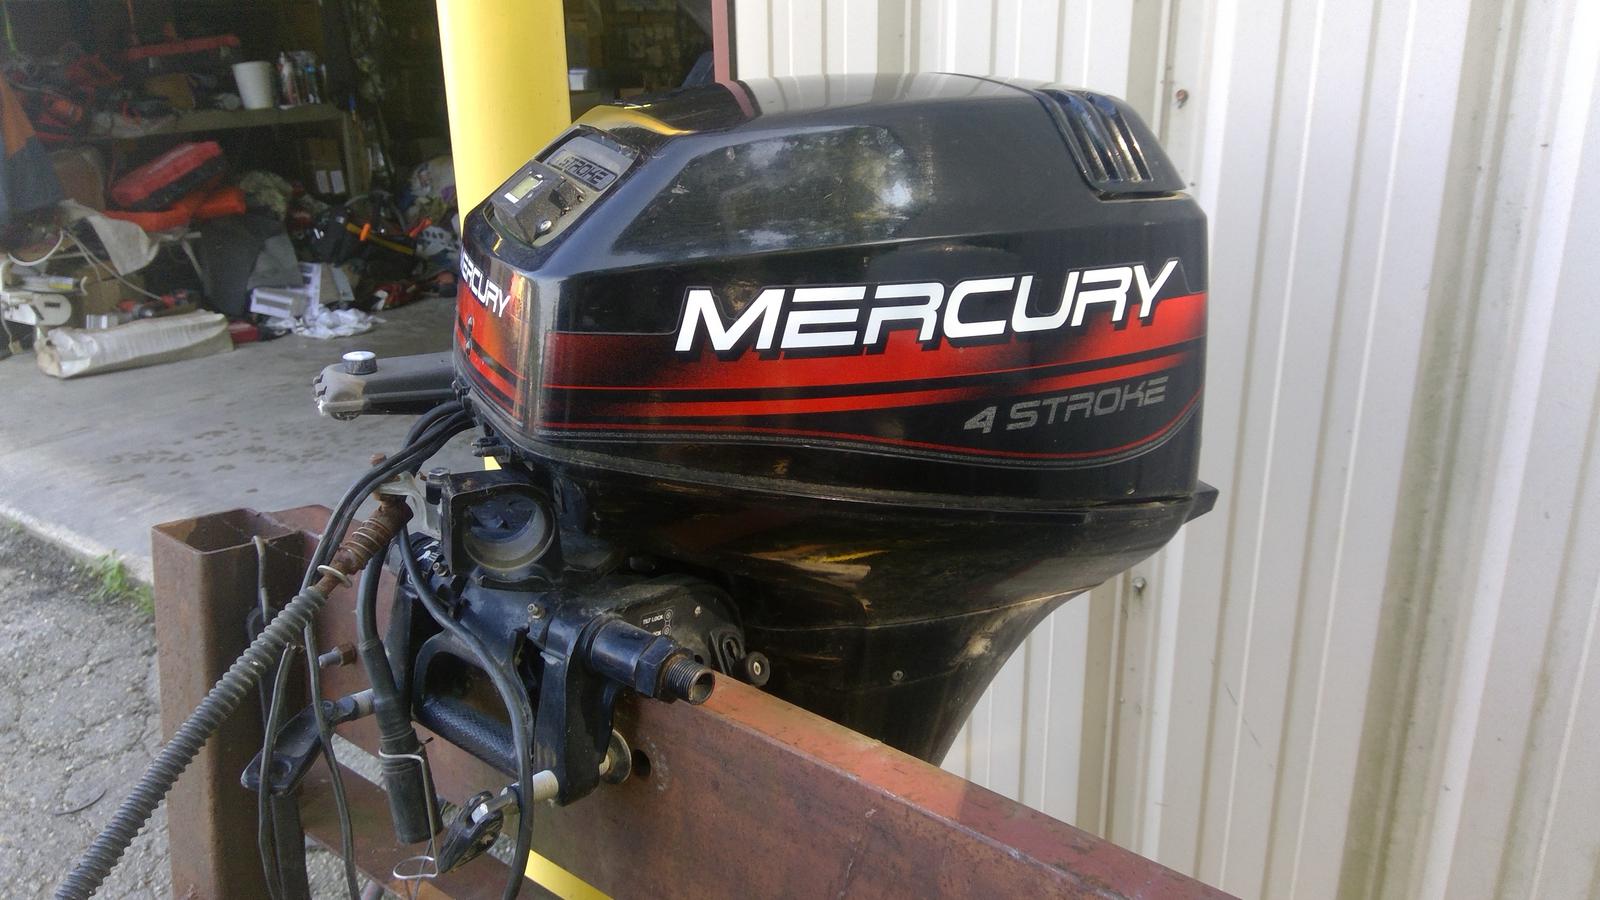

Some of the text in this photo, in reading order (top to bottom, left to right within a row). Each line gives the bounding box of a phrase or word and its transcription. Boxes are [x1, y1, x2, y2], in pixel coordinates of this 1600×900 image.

[460, 245, 511, 317] ERCURY
[675, 260, 1178, 353] MERCURY
[963, 376, 1169, 434] 4 STROKE
[651, 614, 664, 623] LOCK
